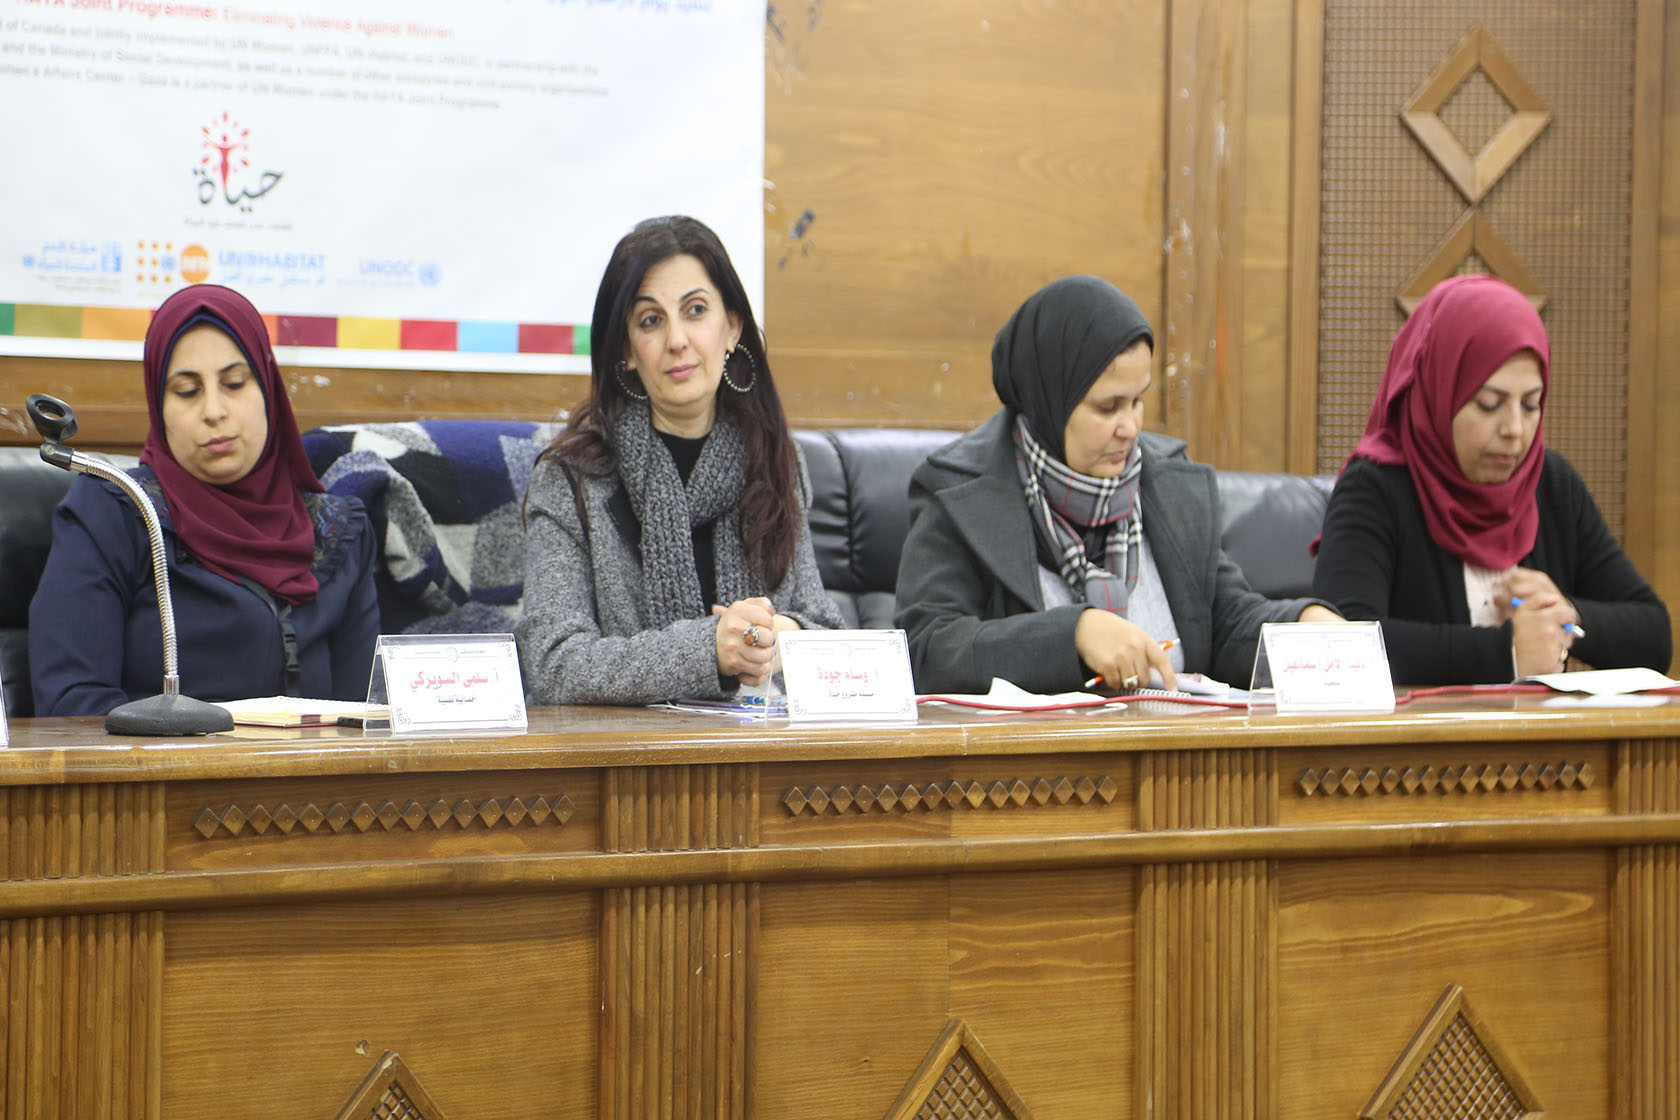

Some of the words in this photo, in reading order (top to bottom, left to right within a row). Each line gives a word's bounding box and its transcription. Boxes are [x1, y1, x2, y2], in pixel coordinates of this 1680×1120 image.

[23, 20, 66, 35] Canada
[70, 26, 92, 37] and
[223, 7, 296, 31] Eliminating
[301, 14, 352, 30] Violence
[357, 19, 402, 37] Against
[407, 24, 455, 39] Women
[51, 44, 96, 61] Ministry
[410, 671, 460, 693] السويركي
[463, 671, 488, 688] سلمى
